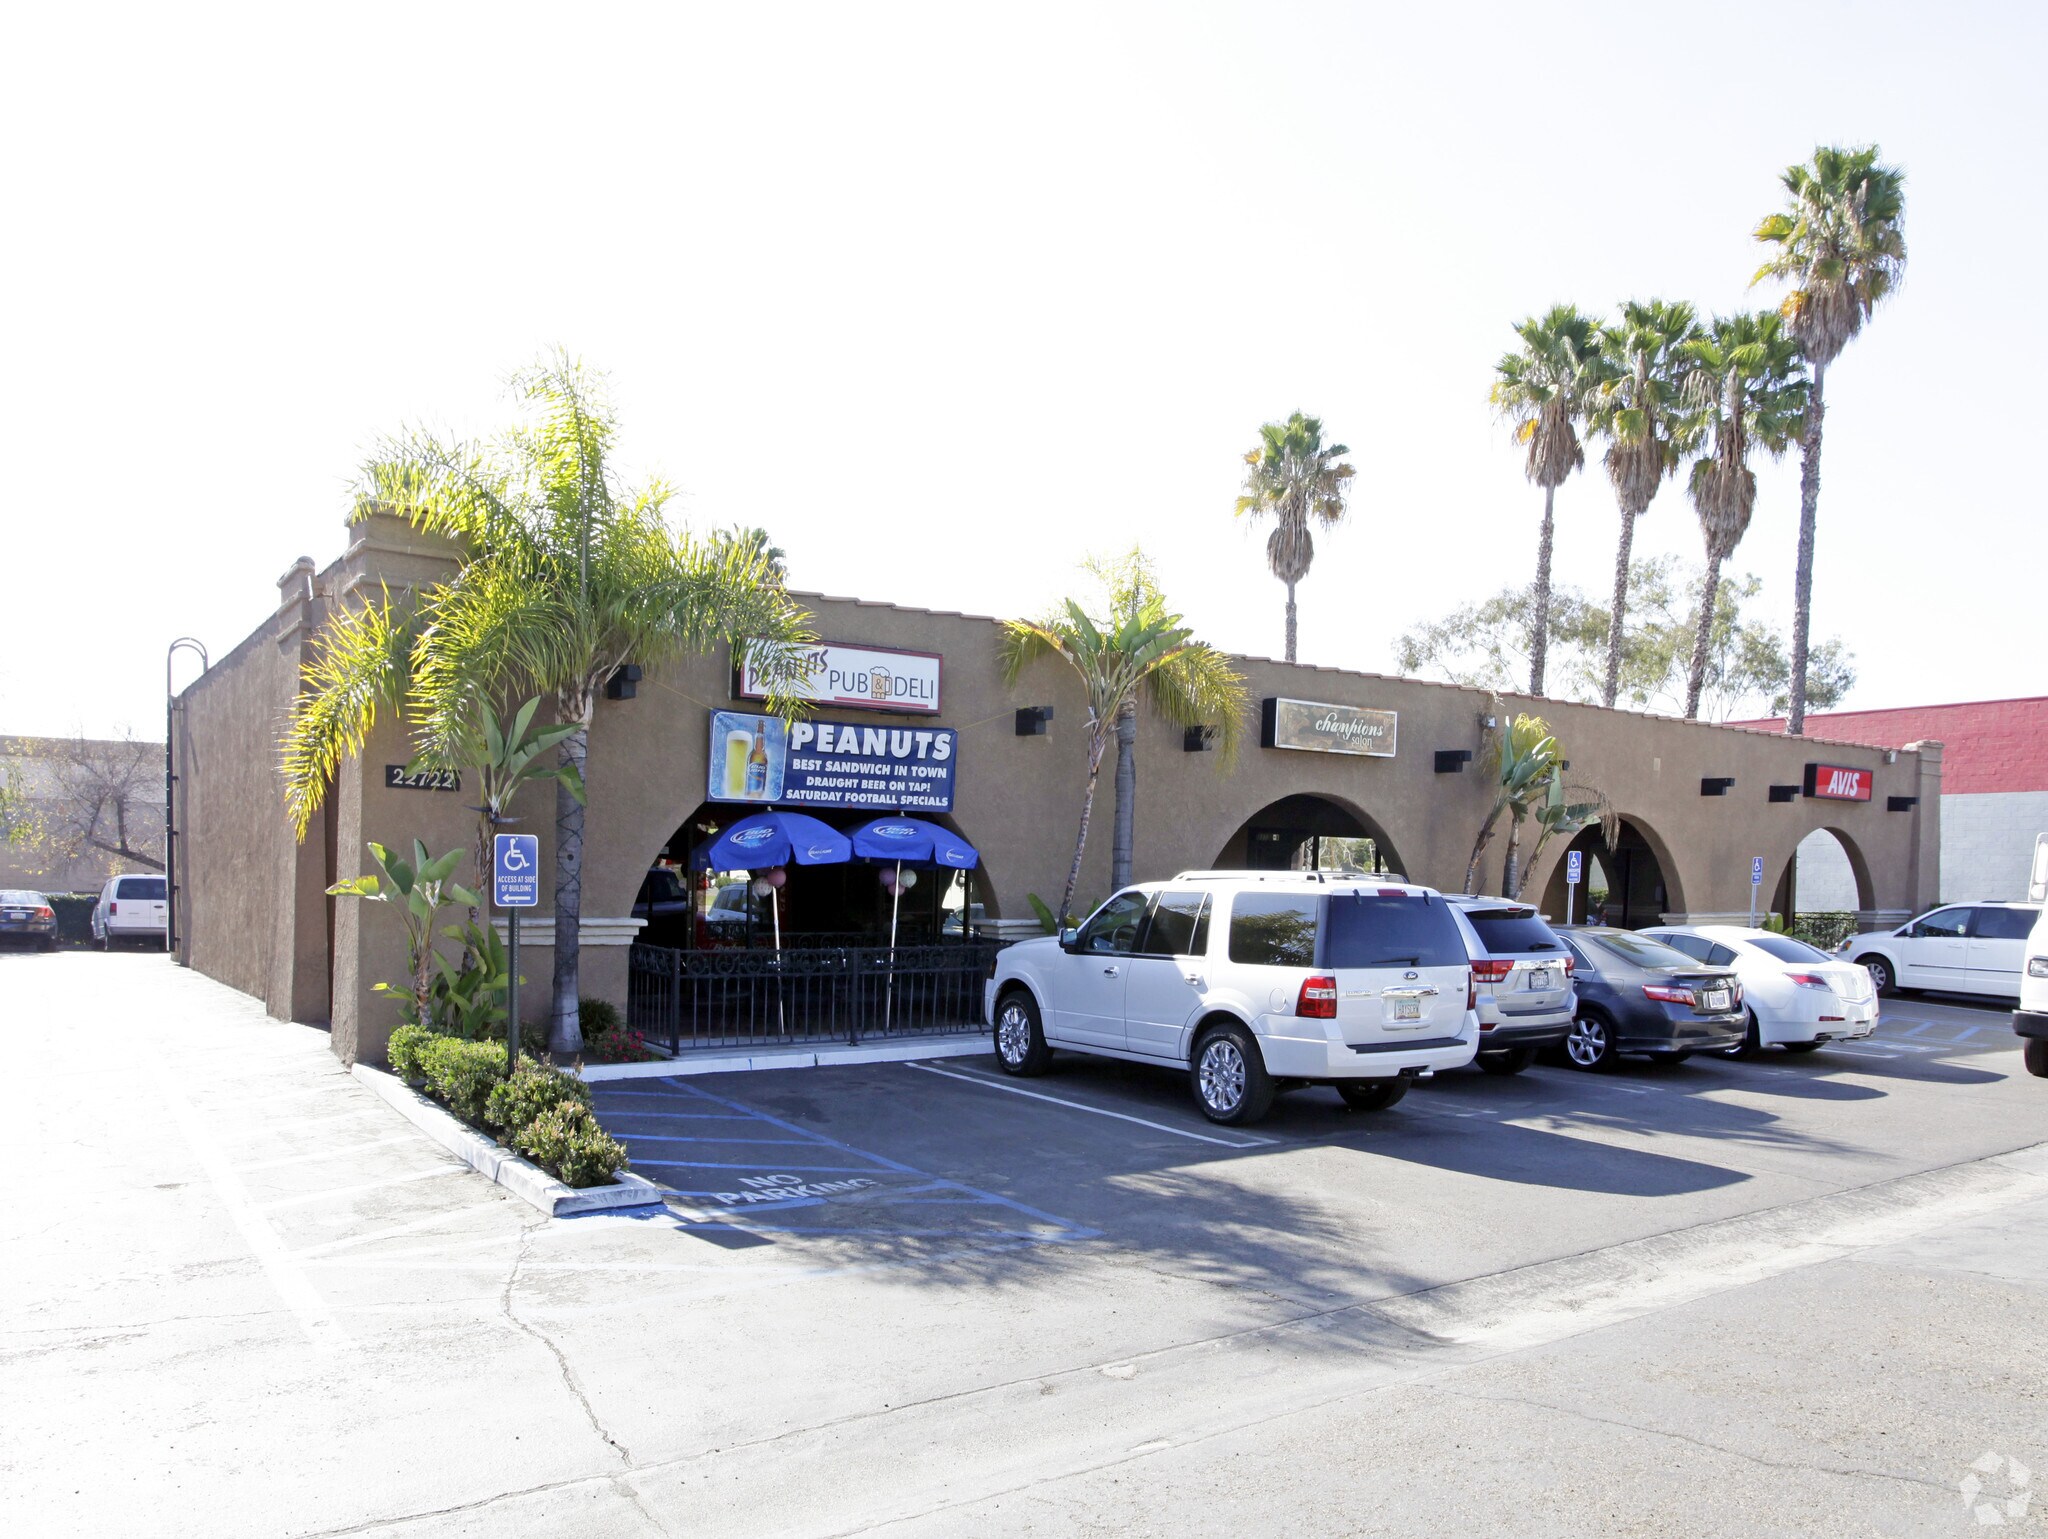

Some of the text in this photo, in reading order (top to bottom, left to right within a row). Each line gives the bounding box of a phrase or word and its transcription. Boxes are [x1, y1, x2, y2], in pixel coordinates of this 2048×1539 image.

[829, 669, 868, 693] PUB
[875, 678, 883, 690] &
[894, 676, 934, 699] DELI
[791, 721, 951, 761] PEANUTS
[1351, 734, 1373, 750] salon
[792, 758, 947, 779] BEST SANDWICH IN TOWN
[806, 776, 931, 793] DRAUGHT BEER ON TAP!
[1827, 770, 1860, 797] AVIS
[785, 789, 949, 807] SATURDAY FOOTBALL SPECIALS
[739, 831, 775, 841] LIGHT
[497, 875, 536, 883] ACCESS AT SIDE
[501, 884, 532, 892] OF BUILDING
[737, 1174, 803, 1188] NO
[711, 1178, 877, 1205] PARKING
